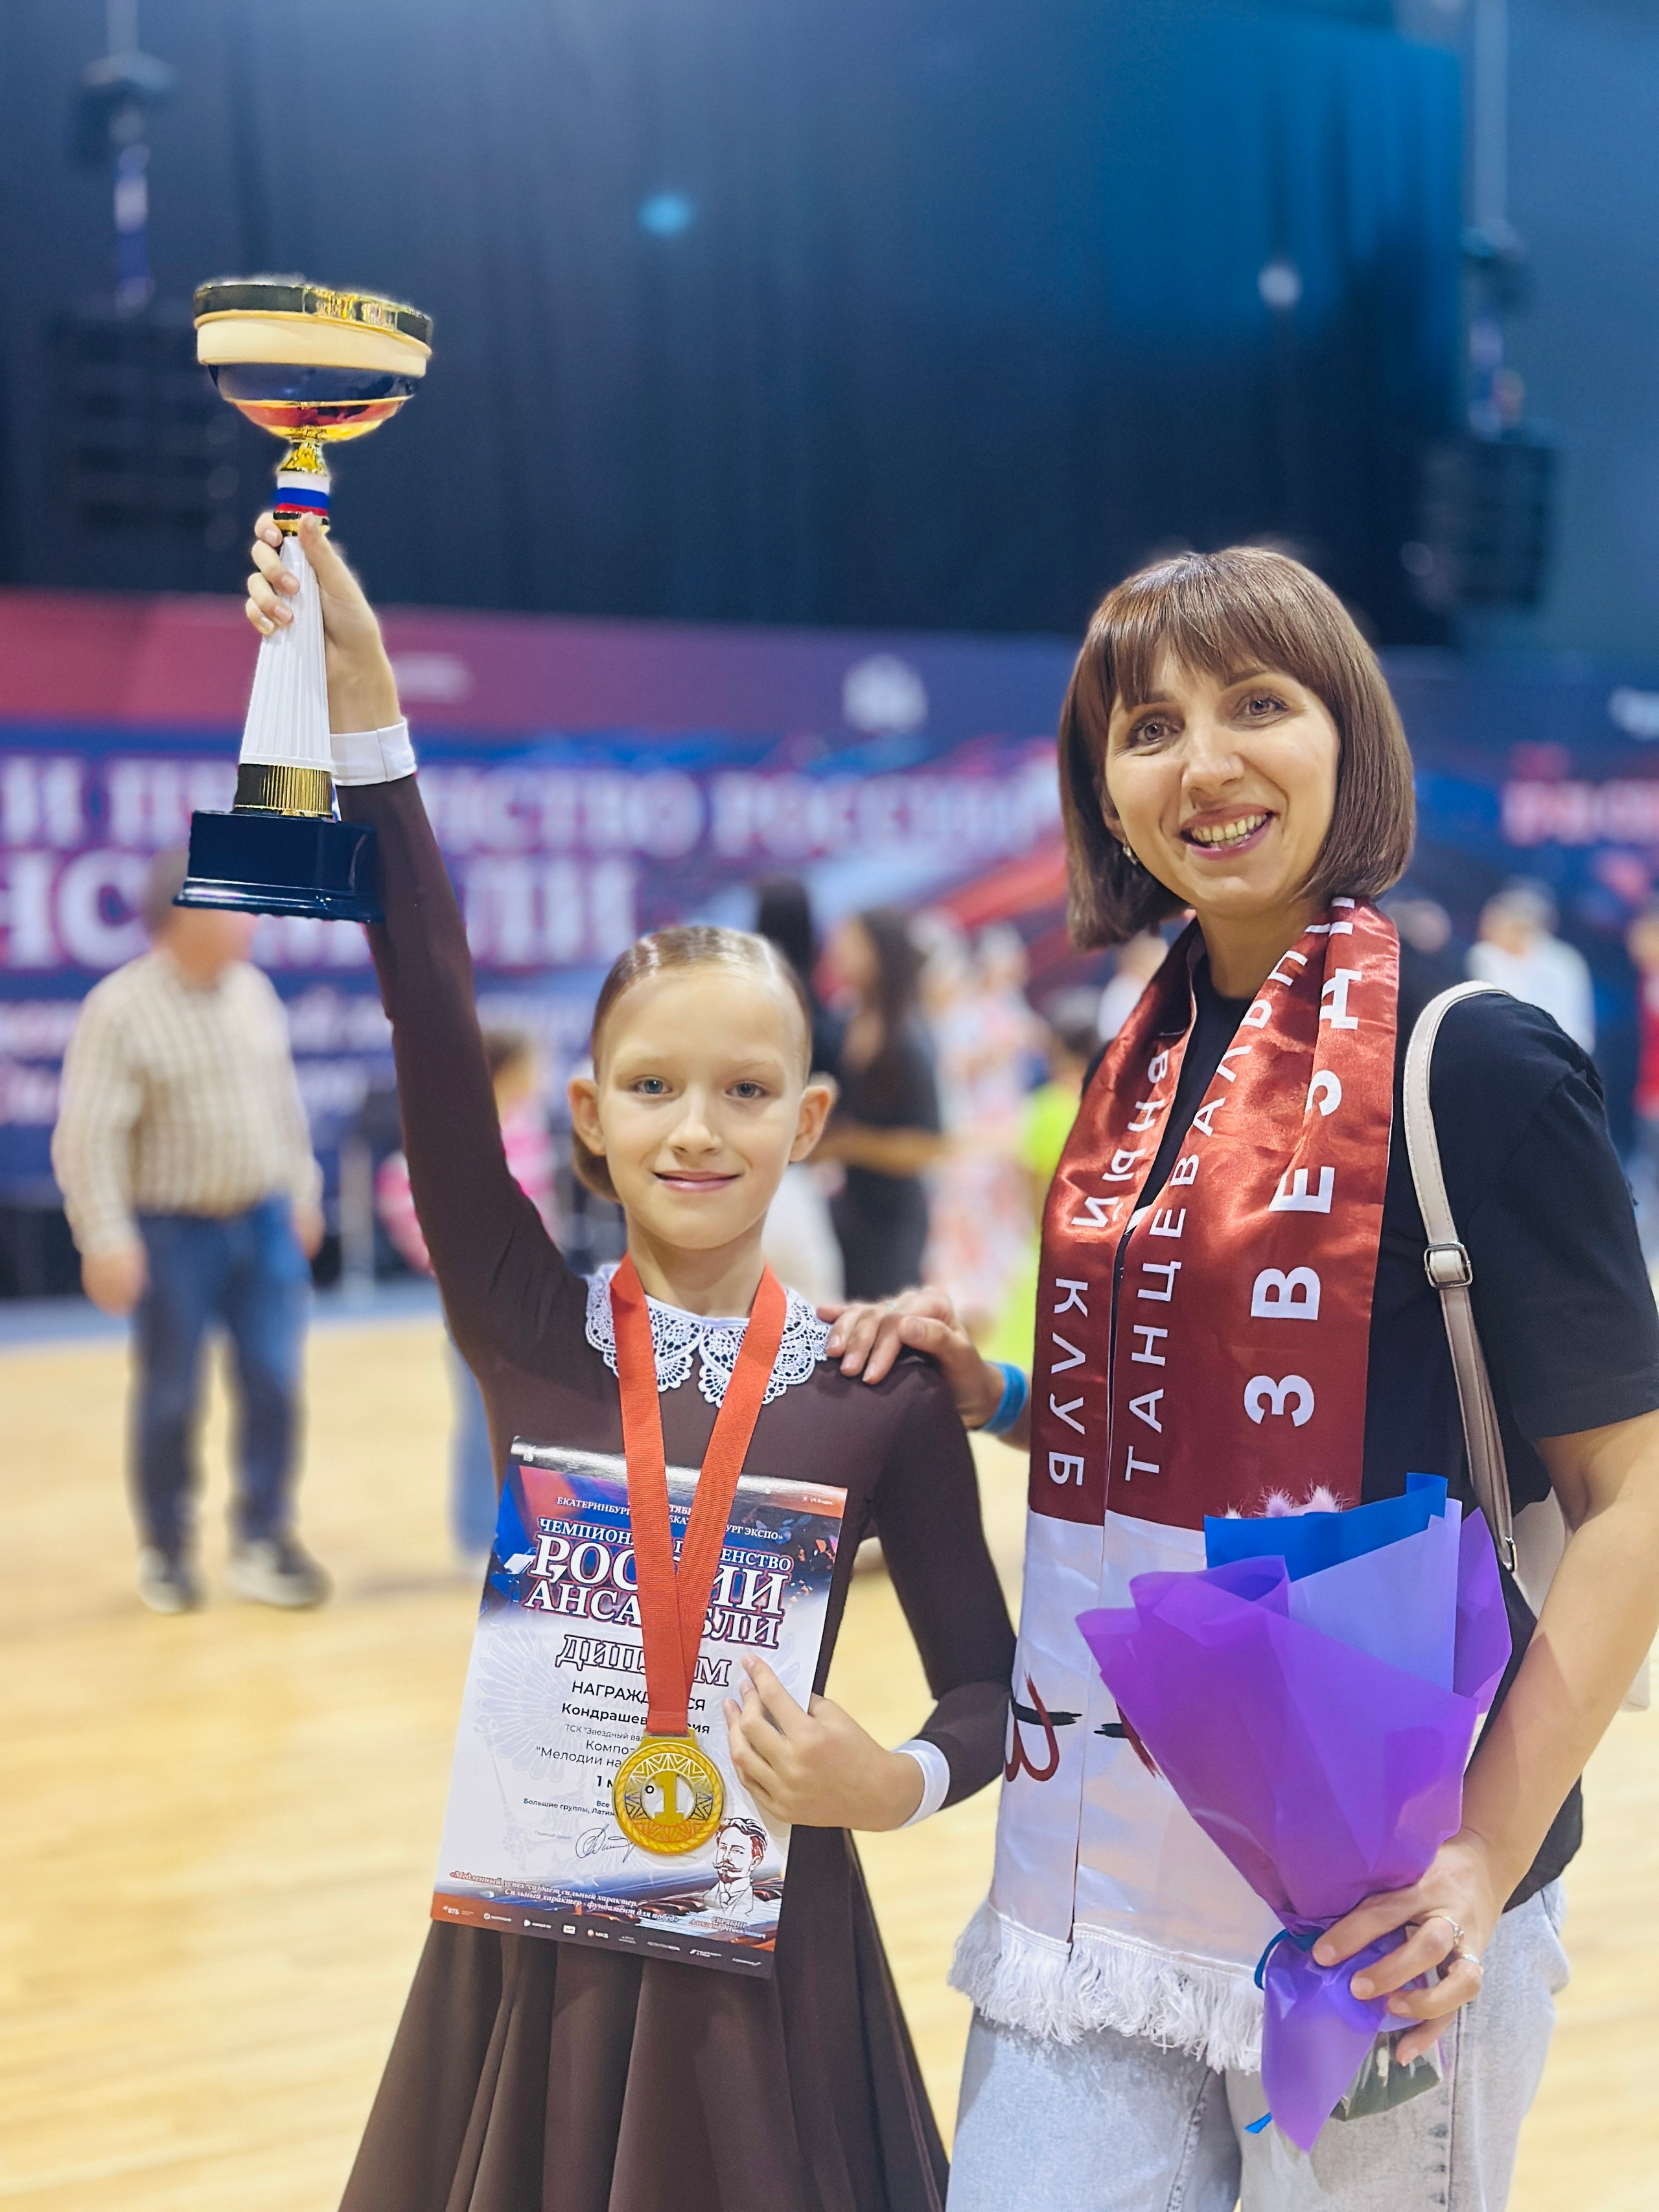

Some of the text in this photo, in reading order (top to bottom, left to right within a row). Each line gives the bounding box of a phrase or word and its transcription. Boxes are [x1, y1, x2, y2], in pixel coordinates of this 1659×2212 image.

[1049, 1277, 1089, 1487] КЛУБ
[539, 1518, 634, 1546] ЧЕМПИОН
[745, 1527, 783, 1540] ЭКСПО»
[561, 1703, 647, 1727] Кондрашев
[565, 1723, 582, 1733] ТСК
[523, 1798, 559, 1808] Большие
